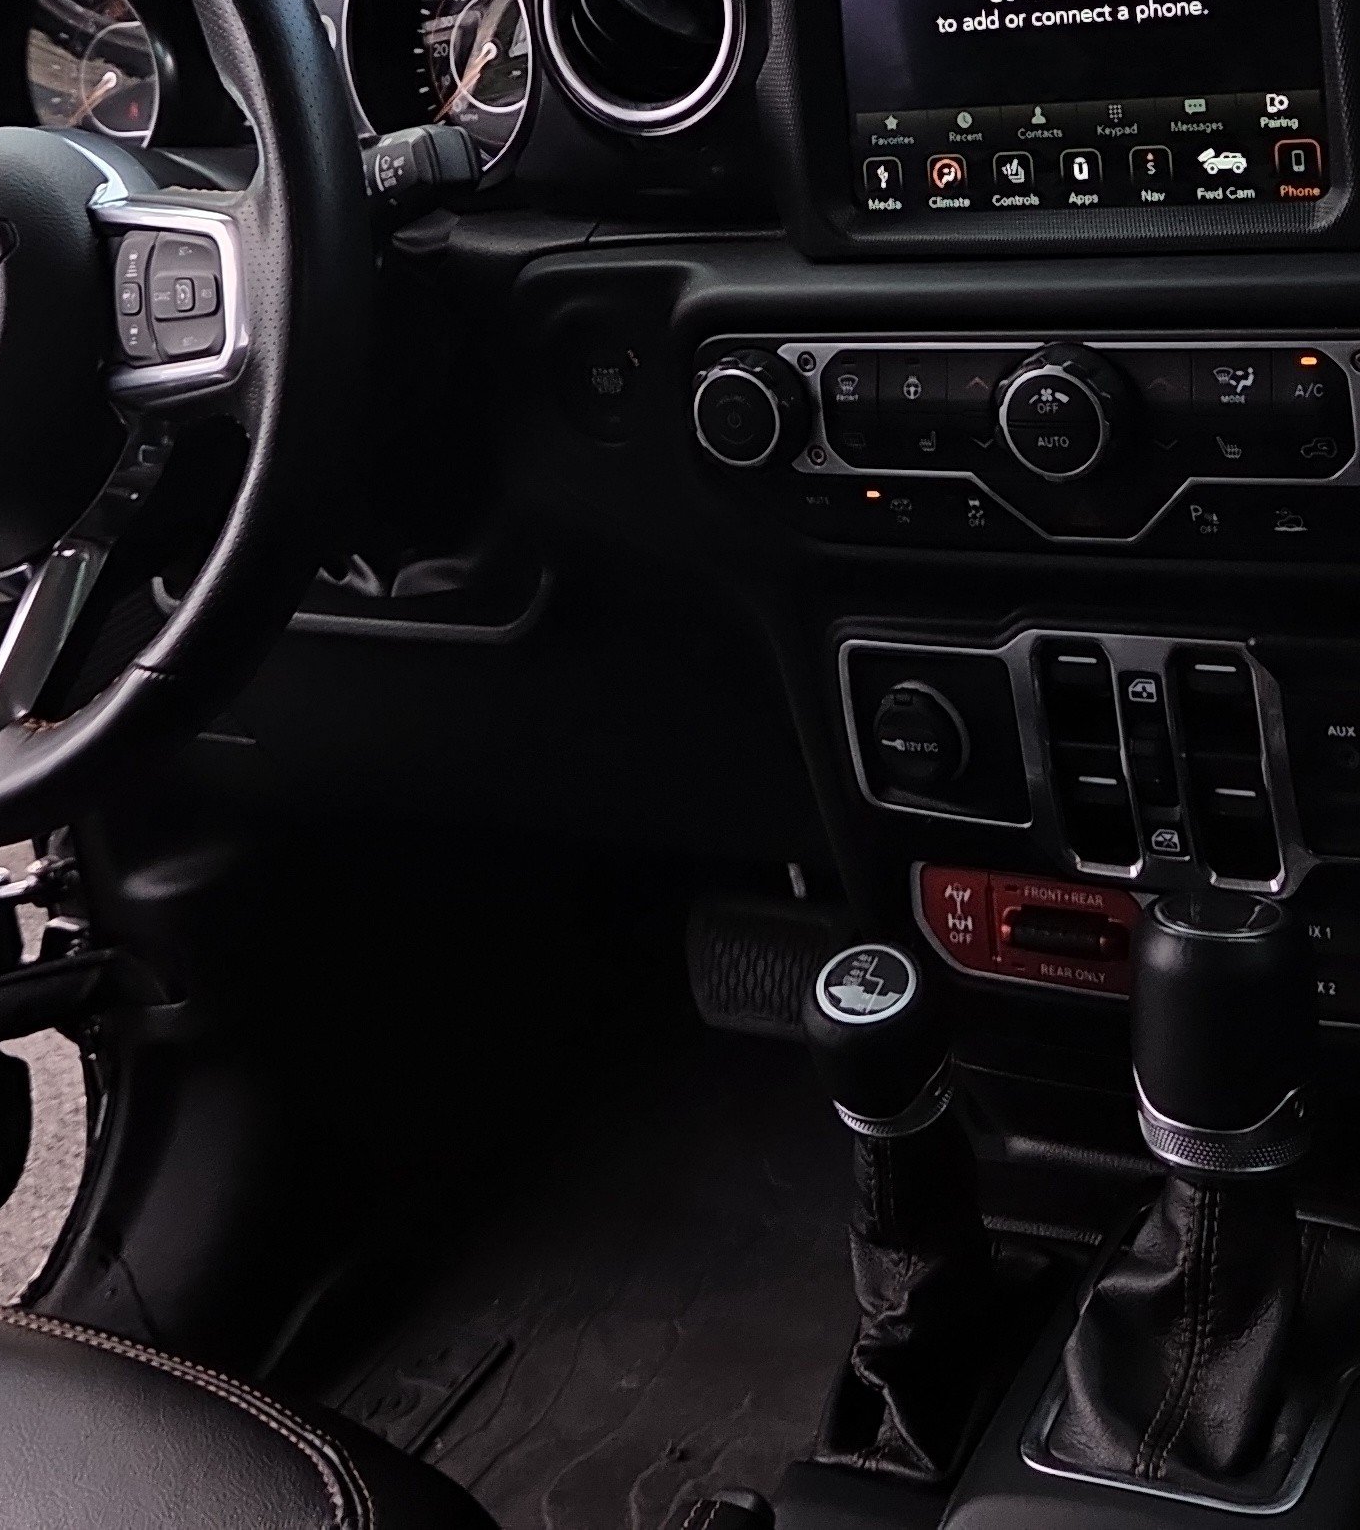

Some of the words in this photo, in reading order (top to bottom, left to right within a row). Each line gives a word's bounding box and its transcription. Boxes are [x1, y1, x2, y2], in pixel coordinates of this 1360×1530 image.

[936, 16, 957, 33] to
[962, 8, 999, 32] add
[1005, 12, 1026, 29] or
[1031, 4, 1113, 27] connect
[1117, 5, 1129, 21] a
[433, 43, 449, 58] 20
[1171, 121, 1224, 134] Messages
[1260, 116, 1299, 130] Pairing
[949, 131, 983, 142] Recent
[1017, 128, 1064, 140] Contacts
[1096, 123, 1138, 137] Keypad
[871, 134, 915, 146] Favorites
[1140, 189, 1166, 202] Nav
[1197, 187, 1224, 200] Fwd
[1226, 186, 1256, 200] Cam
[1279, 185, 1321, 197] Phone
[868, 197, 902, 211] Media
[928, 196, 971, 209] Climate
[992, 193, 1040, 207] Controls
[1069, 191, 1099, 207] Apps
[1294, 383, 1324, 398] A/C
[1220, 394, 1246, 405] MODE
[1036, 402, 1059, 415] OFF
[1037, 435, 1070, 448] AUTO
[1327, 725, 1357, 737] AUX
[923, 742, 939, 752] DC
[949, 931, 973, 944] OFF
[1041, 963, 1072, 978] REAR
[1075, 968, 1107, 984] ONLY
[1328, 981, 1336, 996] 2
